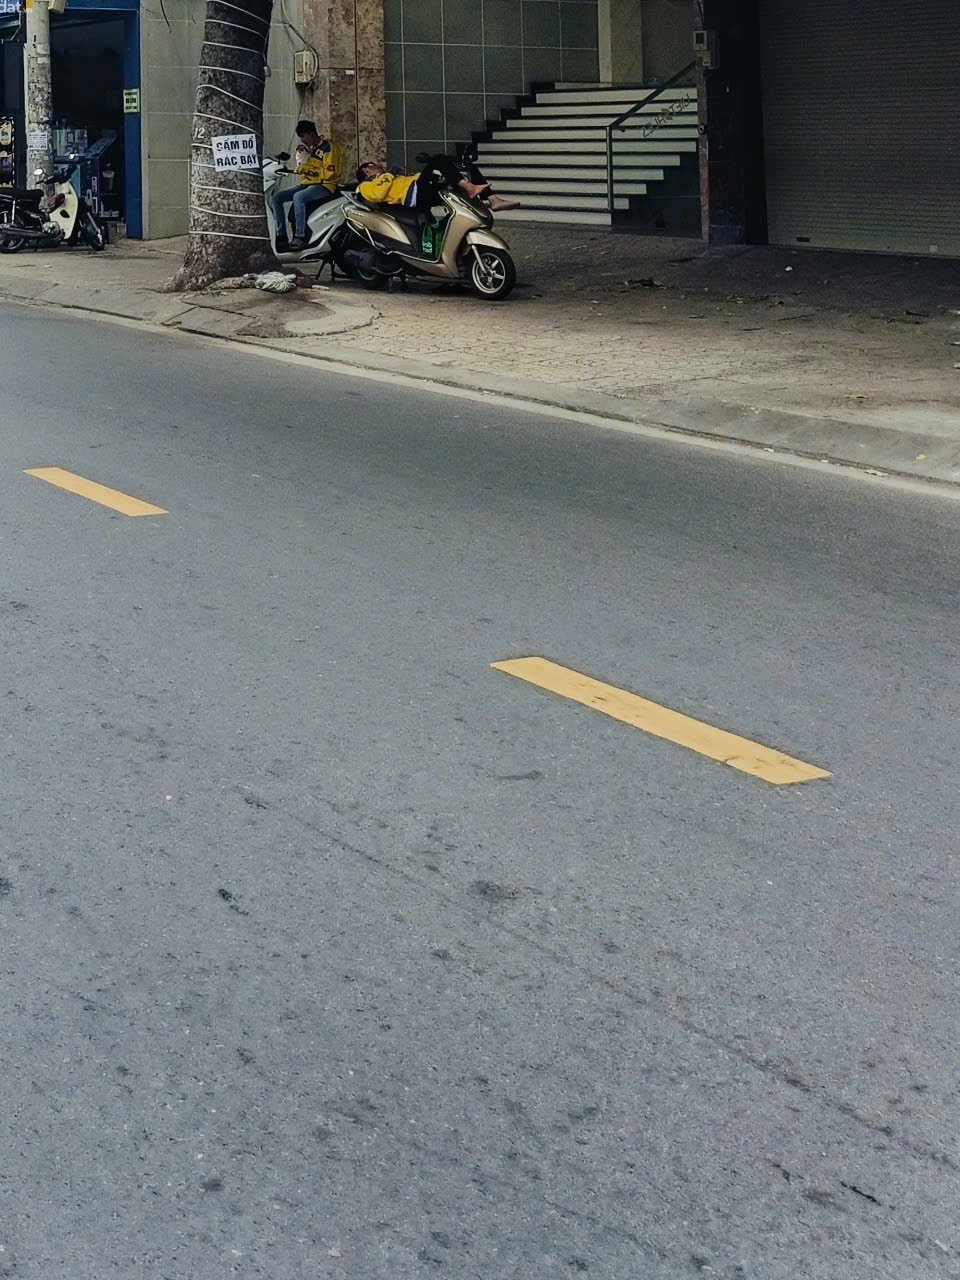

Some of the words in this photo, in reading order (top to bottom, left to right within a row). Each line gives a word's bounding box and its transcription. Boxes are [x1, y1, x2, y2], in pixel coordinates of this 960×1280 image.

[194, 127, 206, 139] 12
[216, 137, 240, 152] CẤM
[216, 155, 238, 167] RÁC
